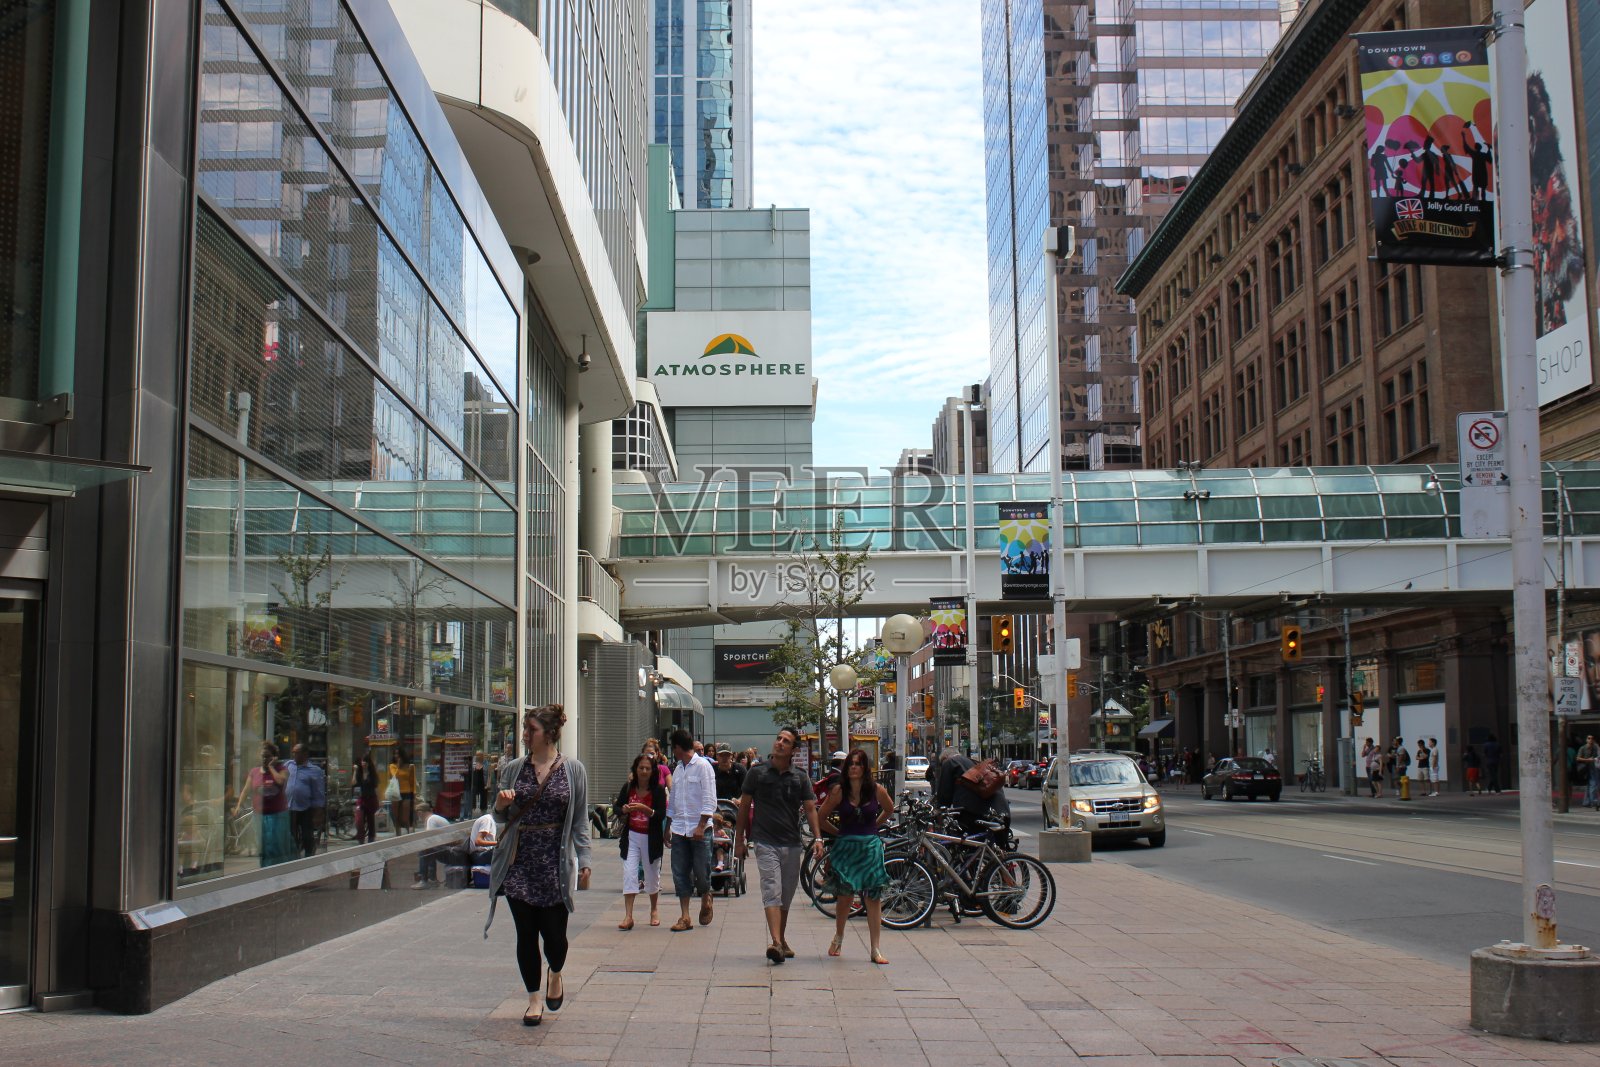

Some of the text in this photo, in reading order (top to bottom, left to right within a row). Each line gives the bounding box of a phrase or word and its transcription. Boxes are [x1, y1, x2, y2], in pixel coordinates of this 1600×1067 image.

[1367, 45, 1426, 54] DOWNTOWN
[1427, 201, 1481, 212] Jolly Good Fun.
[1429, 222, 1470, 237] RICHMOND
[1539, 340, 1583, 385] SHOP
[654, 363, 806, 376] ATMOSPHERE
